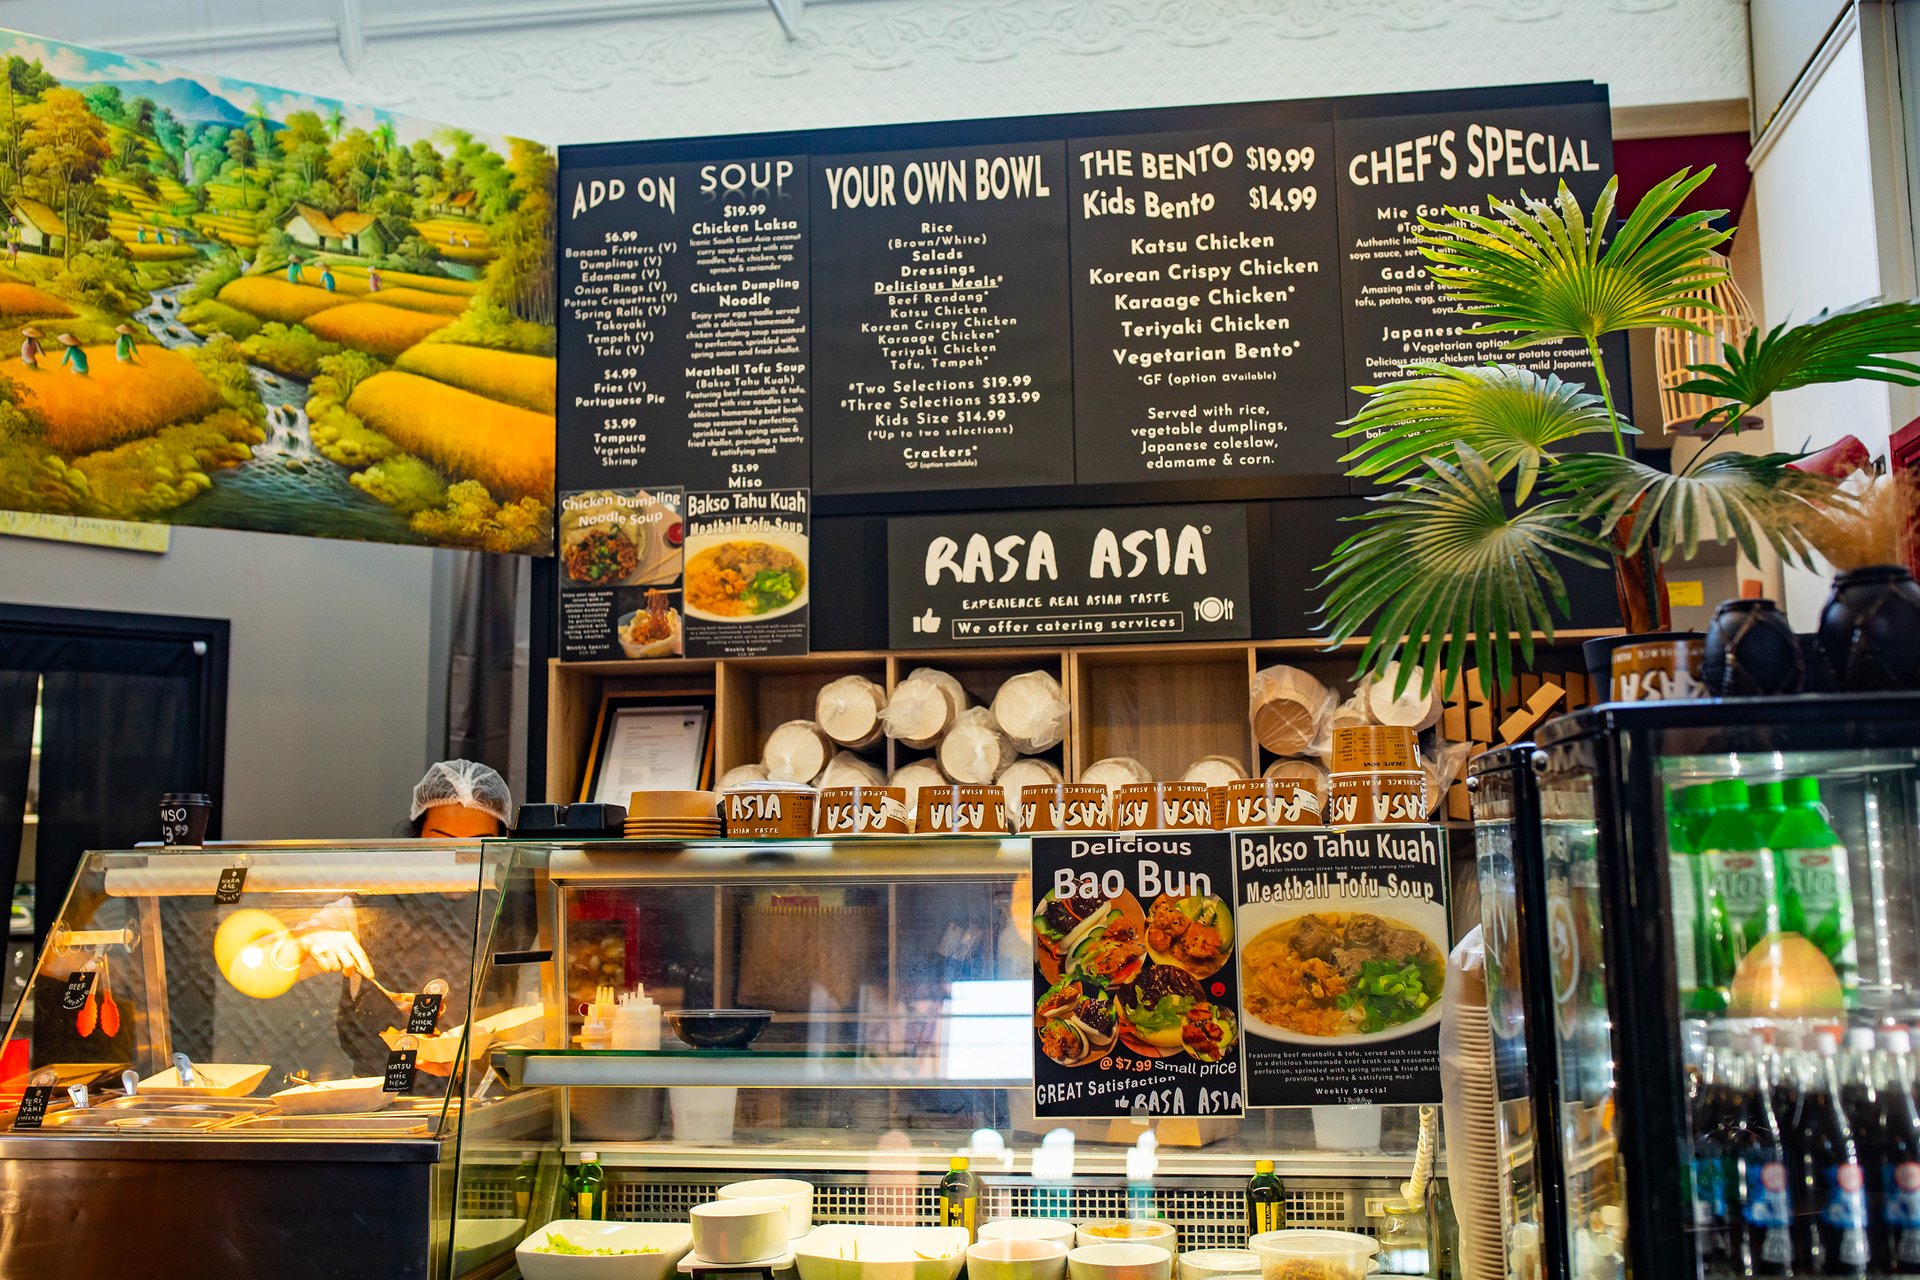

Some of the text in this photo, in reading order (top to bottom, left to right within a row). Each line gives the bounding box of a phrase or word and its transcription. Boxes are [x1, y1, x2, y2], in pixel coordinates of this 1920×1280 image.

[1080, 142, 1315, 180] THE BENTO $19.99
[1349, 124, 1600, 186] CHEF'S SPECIAL
[700, 160, 794, 193] SOUP
[825, 155, 1050, 209] YOUR OWN BOWL
[572, 176, 675, 219] ADD ON
[1083, 185, 1317, 219] Kids Bento $14.99
[724, 204, 766, 218] $19.99
[1377, 207, 1408, 220] Mie
[692, 217, 797, 235] Chicken Laksa
[921, 222, 953, 233] Rice
[605, 231, 638, 243] $6.99
[888, 233, 987, 250] (Brown/White)
[1131, 231, 1274, 255] Katsu Chicken
[565, 245, 654, 258] Banana Fritters
[912, 248, 963, 262] Salads
[1349, 252, 1371, 261] soya
[580, 258, 639, 270] Dumplings
[901, 264, 975, 277] Dressings
[1089, 256, 1319, 285] Korean Crispy Chicken
[582, 271, 637, 282] Edamame
[1381, 266, 1426, 280] Gado
[574, 283, 644, 295] Onion Rings
[690, 278, 799, 293] Chicken Dumpling
[1361, 285, 1403, 294] Amazing
[564, 296, 657, 307] Potato Croquettes
[719, 292, 771, 307] Noodle
[1115, 294, 1200, 311] Karaage
[1355, 296, 1412, 307] tofu, potato,
[575, 306, 643, 321] Spring Rolls
[891, 304, 987, 318] Katsu Chicken
[596, 319, 646, 331] Takoyaki
[861, 315, 1017, 333] Korean Crispy Chicken
[1121, 313, 1289, 339] Teriyaki Chicken
[587, 332, 631, 345] Tempeh
[1382, 326, 1466, 341] Japanese
[596, 345, 621, 356] Tofu
[882, 342, 996, 358] Teriyaki Chicken
[1412, 340, 1473, 353] Vegetarian
[1113, 346, 1226, 368] Vegetarian
[1477, 350, 1551, 361] katsu potato
[604, 368, 637, 380] $4.99
[685, 362, 805, 377] Meatball Tofu Soup
[696, 374, 795, 389] (Bakso Tahu Kuah)
[893, 375, 1031, 393] Selections $19.99
[1168, 371, 1276, 386] (option available)
[594, 383, 623, 393] Fries
[575, 393, 665, 408] Portuguese Pie
[900, 391, 1040, 409] Selections $23.99
[876, 409, 1006, 426] Kids Size $14.99
[1148, 403, 1269, 419] Served with rice,
[604, 418, 637, 430] $3.99
[946, 424, 1013, 436] selections)
[1131, 418, 1287, 439] vegetable dumplings,
[594, 433, 646, 445] Tempura
[1141, 435, 1278, 455] Japanese coleslaw,
[593, 445, 646, 457] Vegetable
[602, 455, 638, 467] Shrimp
[731, 463, 759, 473] $3.99
[1146, 453, 1274, 469] edamame & corn.
[728, 476, 762, 488] Miso
[562, 492, 681, 512] Chicken Dumpling
[687, 491, 806, 517] Bakso Tahu Kuah
[578, 511, 663, 528] Noodle Soup
[690, 516, 803, 536] Meatball Tofu Soup
[925, 524, 1209, 586] RASA ASIA
[962, 592, 1170, 610] EXPERIENCE REAL ASIAN TASTE
[958, 617, 1175, 634] We offer catering services
[731, 793, 782, 820] ASIA
[827, 804, 888, 831] RASA
[930, 804, 984, 830] ASIA
[1071, 838, 1192, 859] Delicious
[1240, 830, 1436, 871] Bakso Tahu Kuah
[1054, 859, 1211, 900] Bao Bun
[1246, 872, 1434, 904] Meatball Tofu Soup
[1115, 1058, 1237, 1078] $7.99 Small price
[1036, 1075, 1176, 1106] GREAT Satisfaction
[1315, 1087, 1387, 1095] Weekly Special
[1134, 1086, 1242, 1115] RASA ASIA
